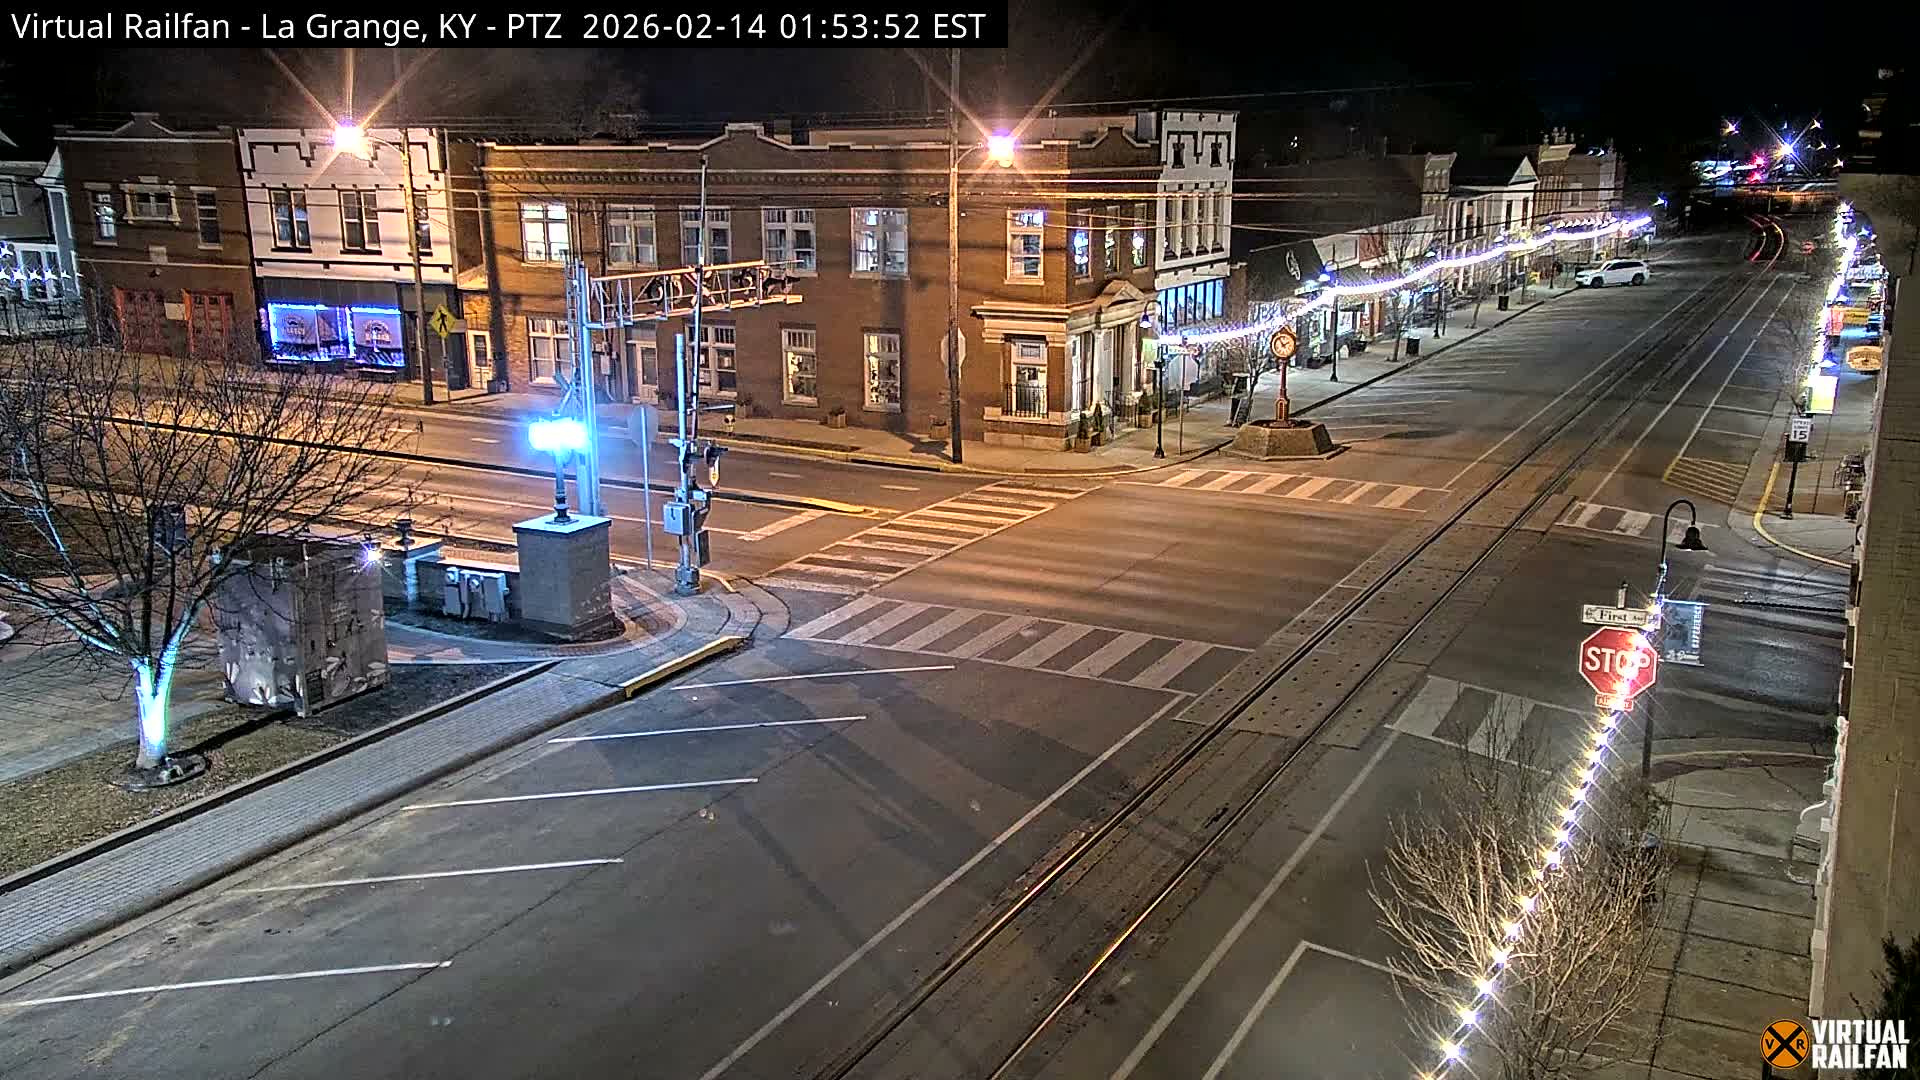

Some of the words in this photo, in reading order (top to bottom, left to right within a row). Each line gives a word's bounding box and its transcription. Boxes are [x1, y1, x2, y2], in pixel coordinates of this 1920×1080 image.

[1793, 430, 1808, 440] 15
[1599, 609, 1627, 621] First
[1585, 646, 1651, 677] STOP
